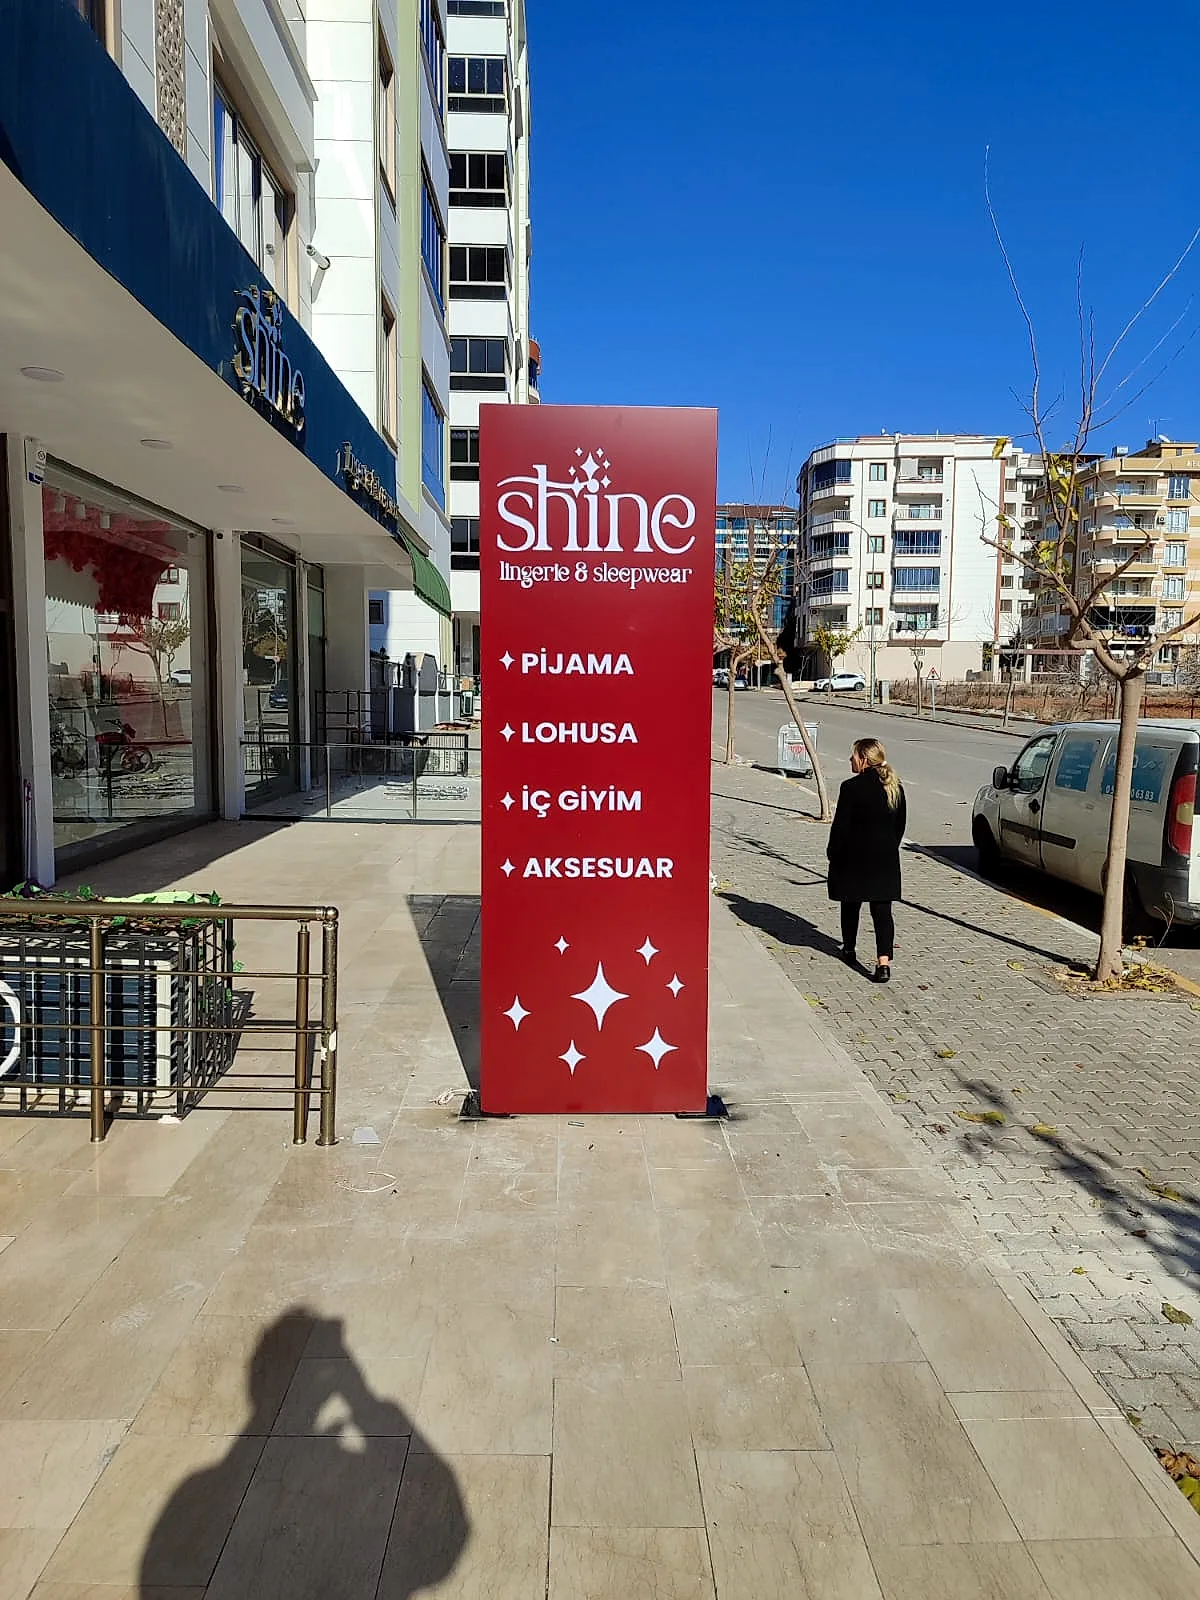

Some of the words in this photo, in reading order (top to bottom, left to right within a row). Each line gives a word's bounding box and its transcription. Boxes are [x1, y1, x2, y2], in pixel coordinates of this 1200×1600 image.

[233, 284, 305, 431] shine
[496, 464, 696, 554] shine
[499, 560, 570, 589] lingerie
[574, 561, 588, 583] &
[593, 561, 693, 590] sleepwear
[521, 647, 635, 675] PİJAMA
[521, 721, 638, 744] LOHUSA
[522, 784, 551, 818] İÇ
[557, 784, 642, 812] GİYİM
[522, 857, 674, 879] AKSESUAR
